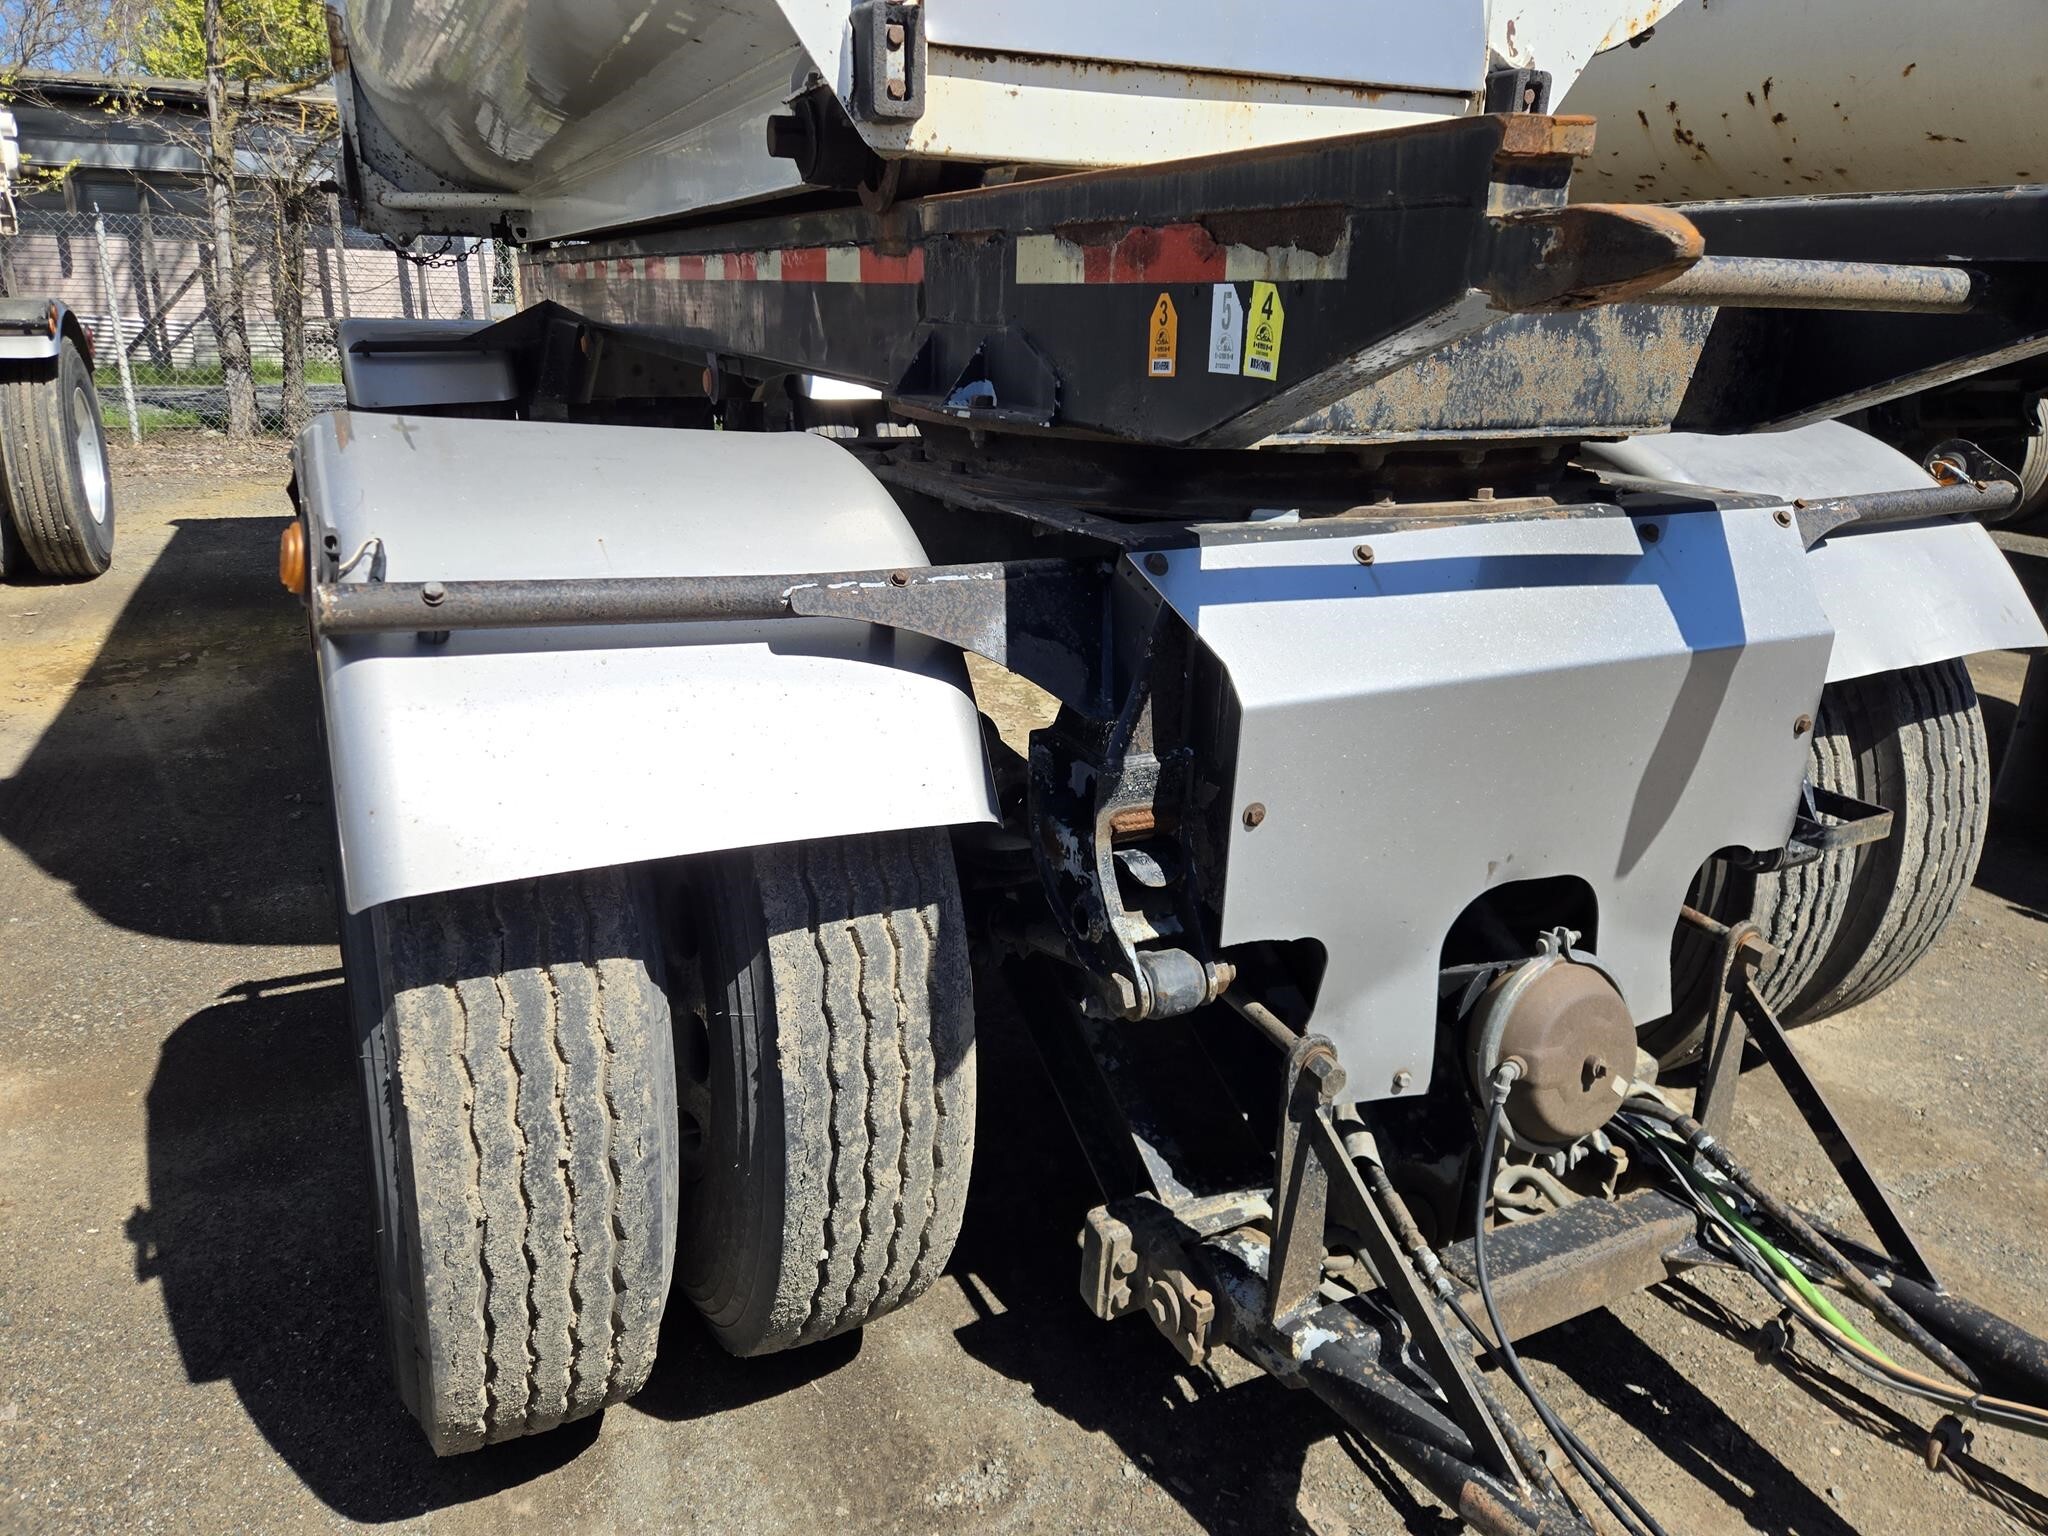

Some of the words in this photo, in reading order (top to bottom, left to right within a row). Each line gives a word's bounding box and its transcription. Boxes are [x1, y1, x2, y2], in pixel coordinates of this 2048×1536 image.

[1159, 300, 1168, 326] 3
[1221, 291, 1232, 331] 5
[1261, 291, 1274, 321] 4
